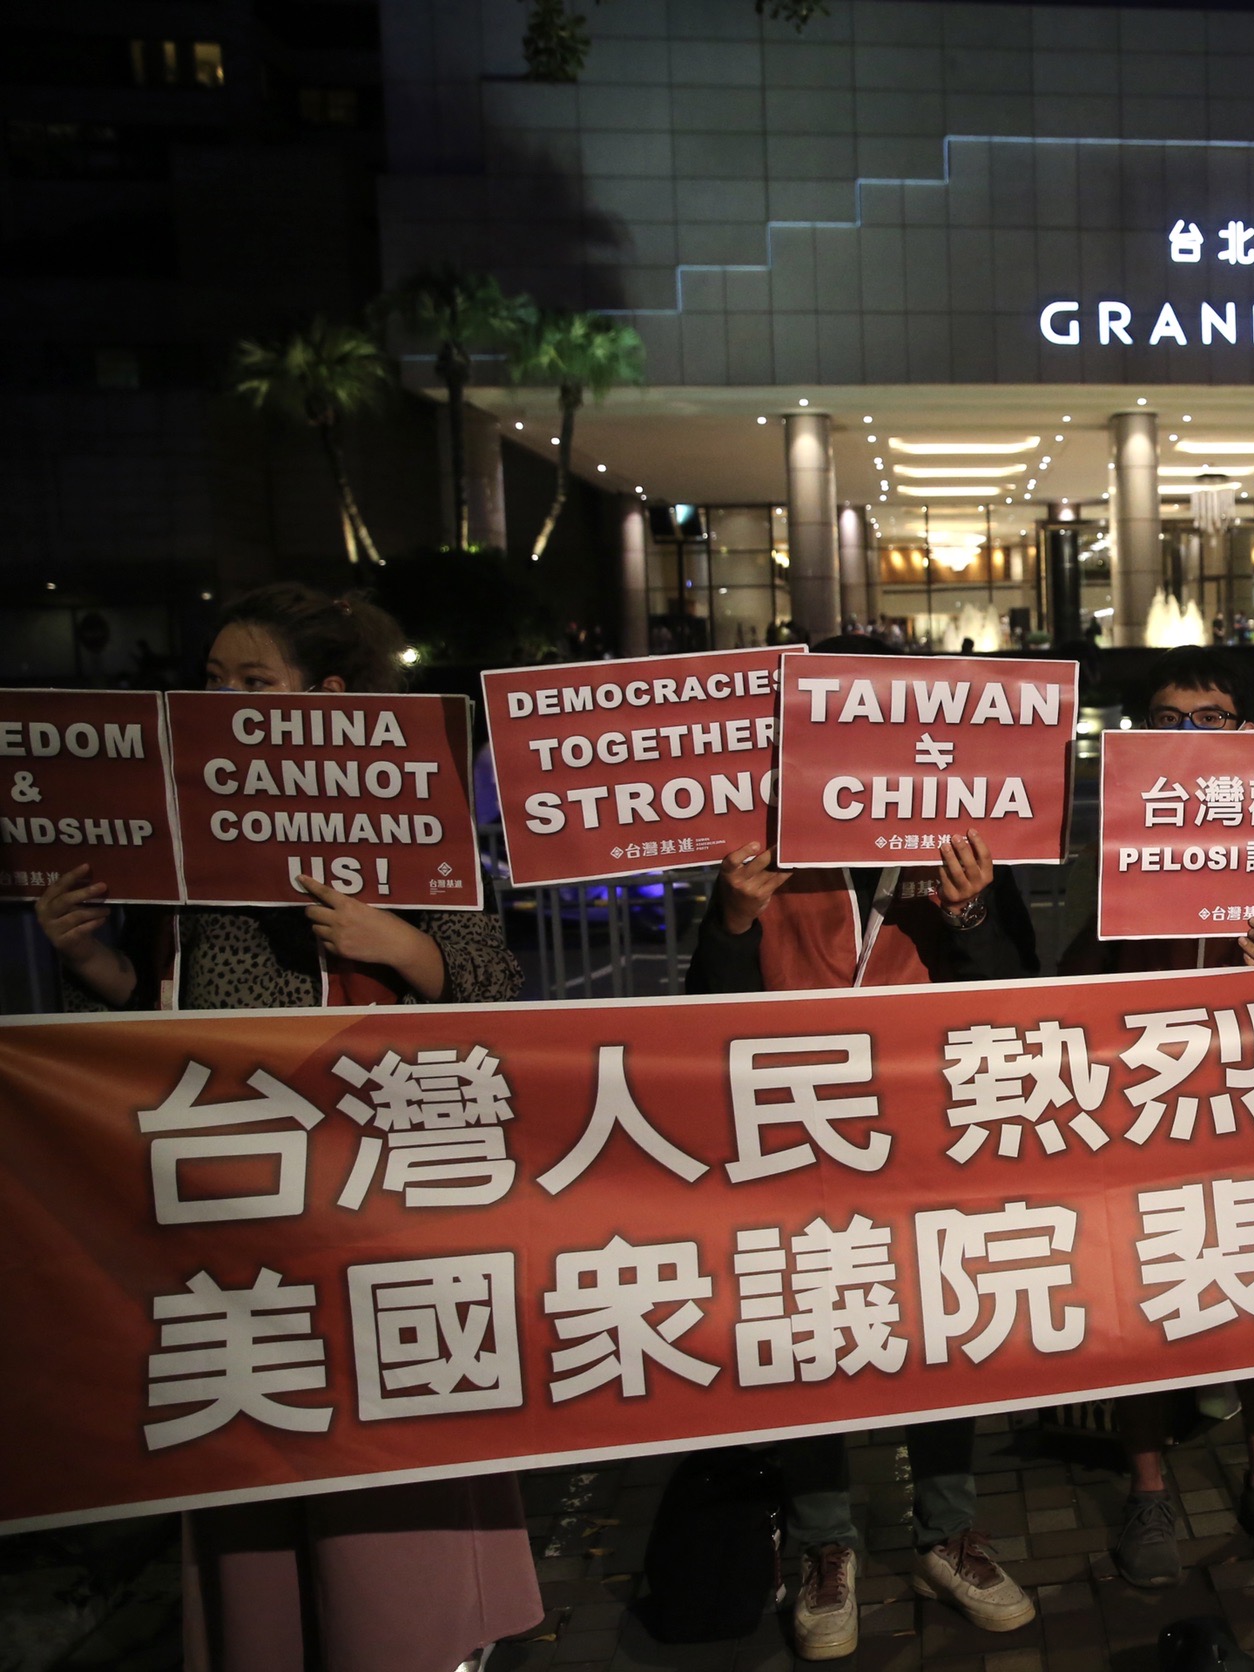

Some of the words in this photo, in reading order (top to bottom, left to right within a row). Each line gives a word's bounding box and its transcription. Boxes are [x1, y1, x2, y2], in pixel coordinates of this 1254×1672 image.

[797, 677, 1061, 726] TAIWAN
[0, 721, 146, 759] EDOM
[231, 708, 407, 747] CHINA
[529, 716, 782, 771] TOGETHER
[10, 770, 43, 803] &
[203, 758, 439, 799] CANNOT
[822, 774, 1034, 820] CHINA
[0, 816, 154, 846] NDSHIP
[210, 809, 444, 845] COMMAND
[625, 837, 695, 859] 台灣基進
[1118, 846, 1239, 873] PELOSI
[137, 1033, 892, 1225] 台灣人民
